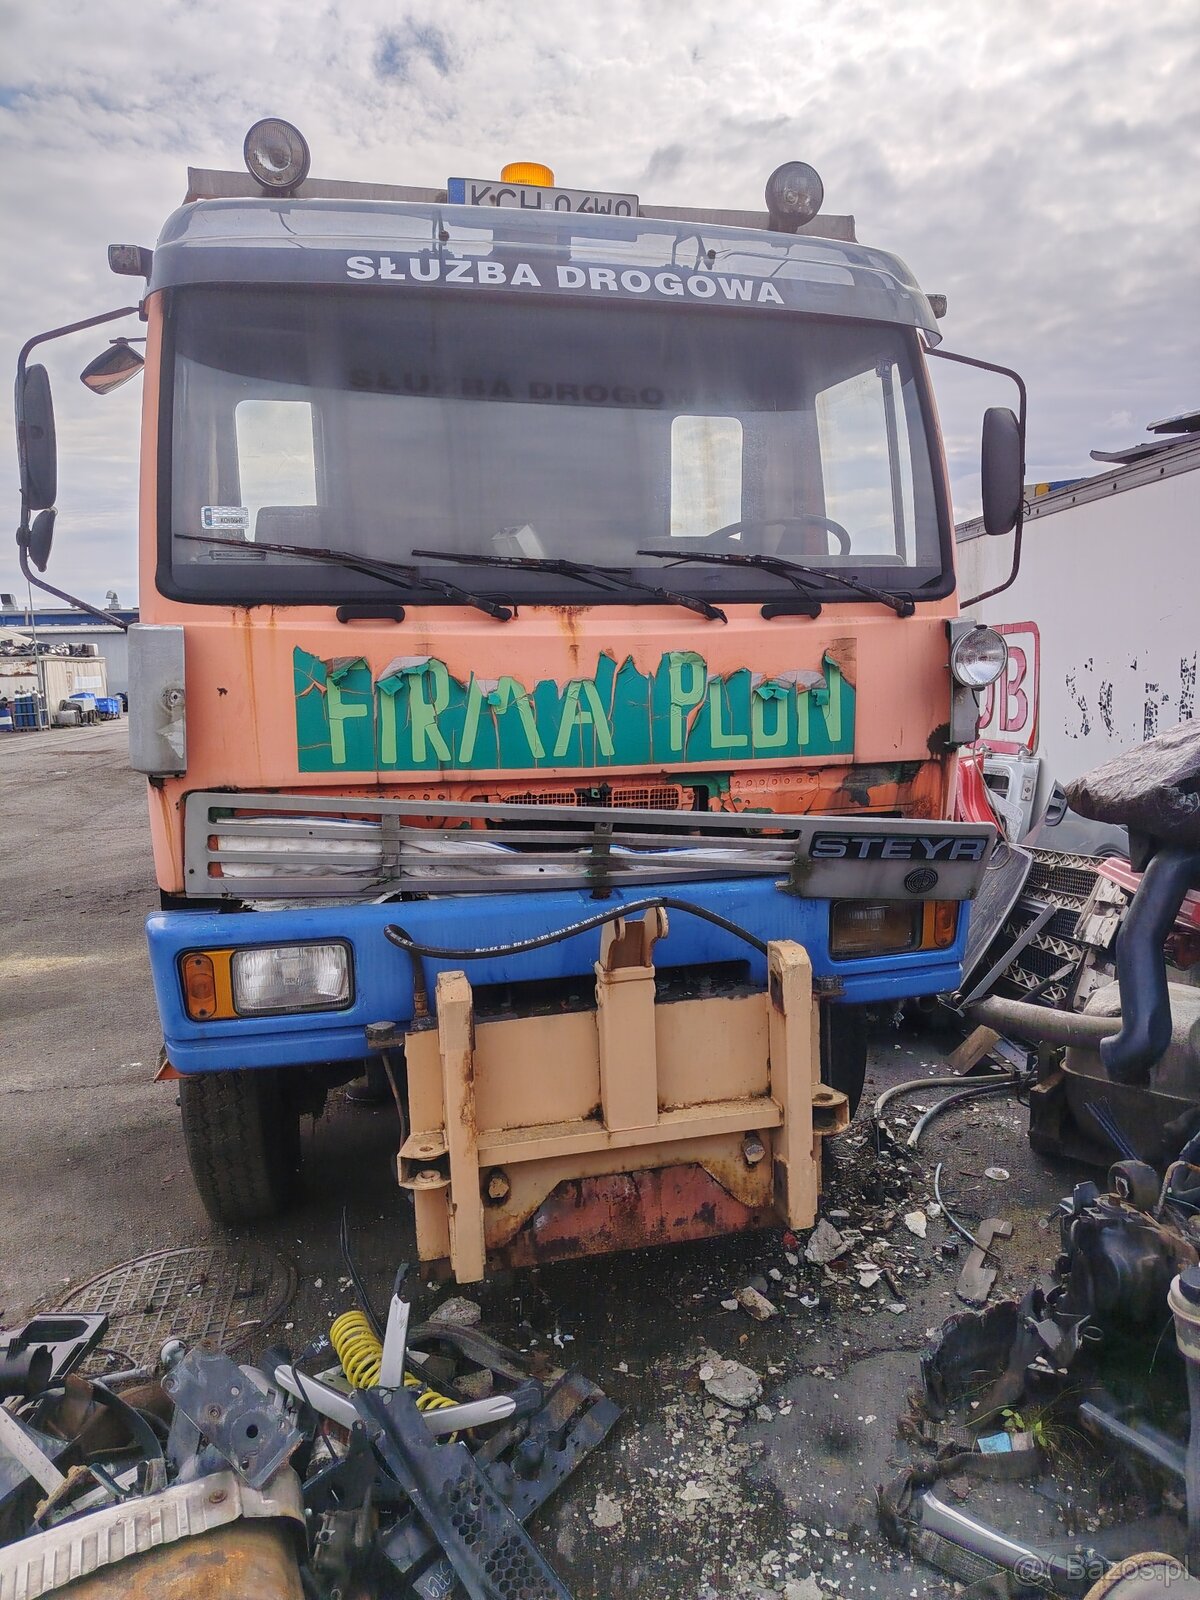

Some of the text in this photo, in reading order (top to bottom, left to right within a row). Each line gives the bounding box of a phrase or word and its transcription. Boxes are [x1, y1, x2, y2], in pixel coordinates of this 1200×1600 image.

[346, 255, 785, 305] SŁUŻBA DROGOWA
[326, 656, 615, 764] FIRMA
[811, 837, 986, 861] STEYR
